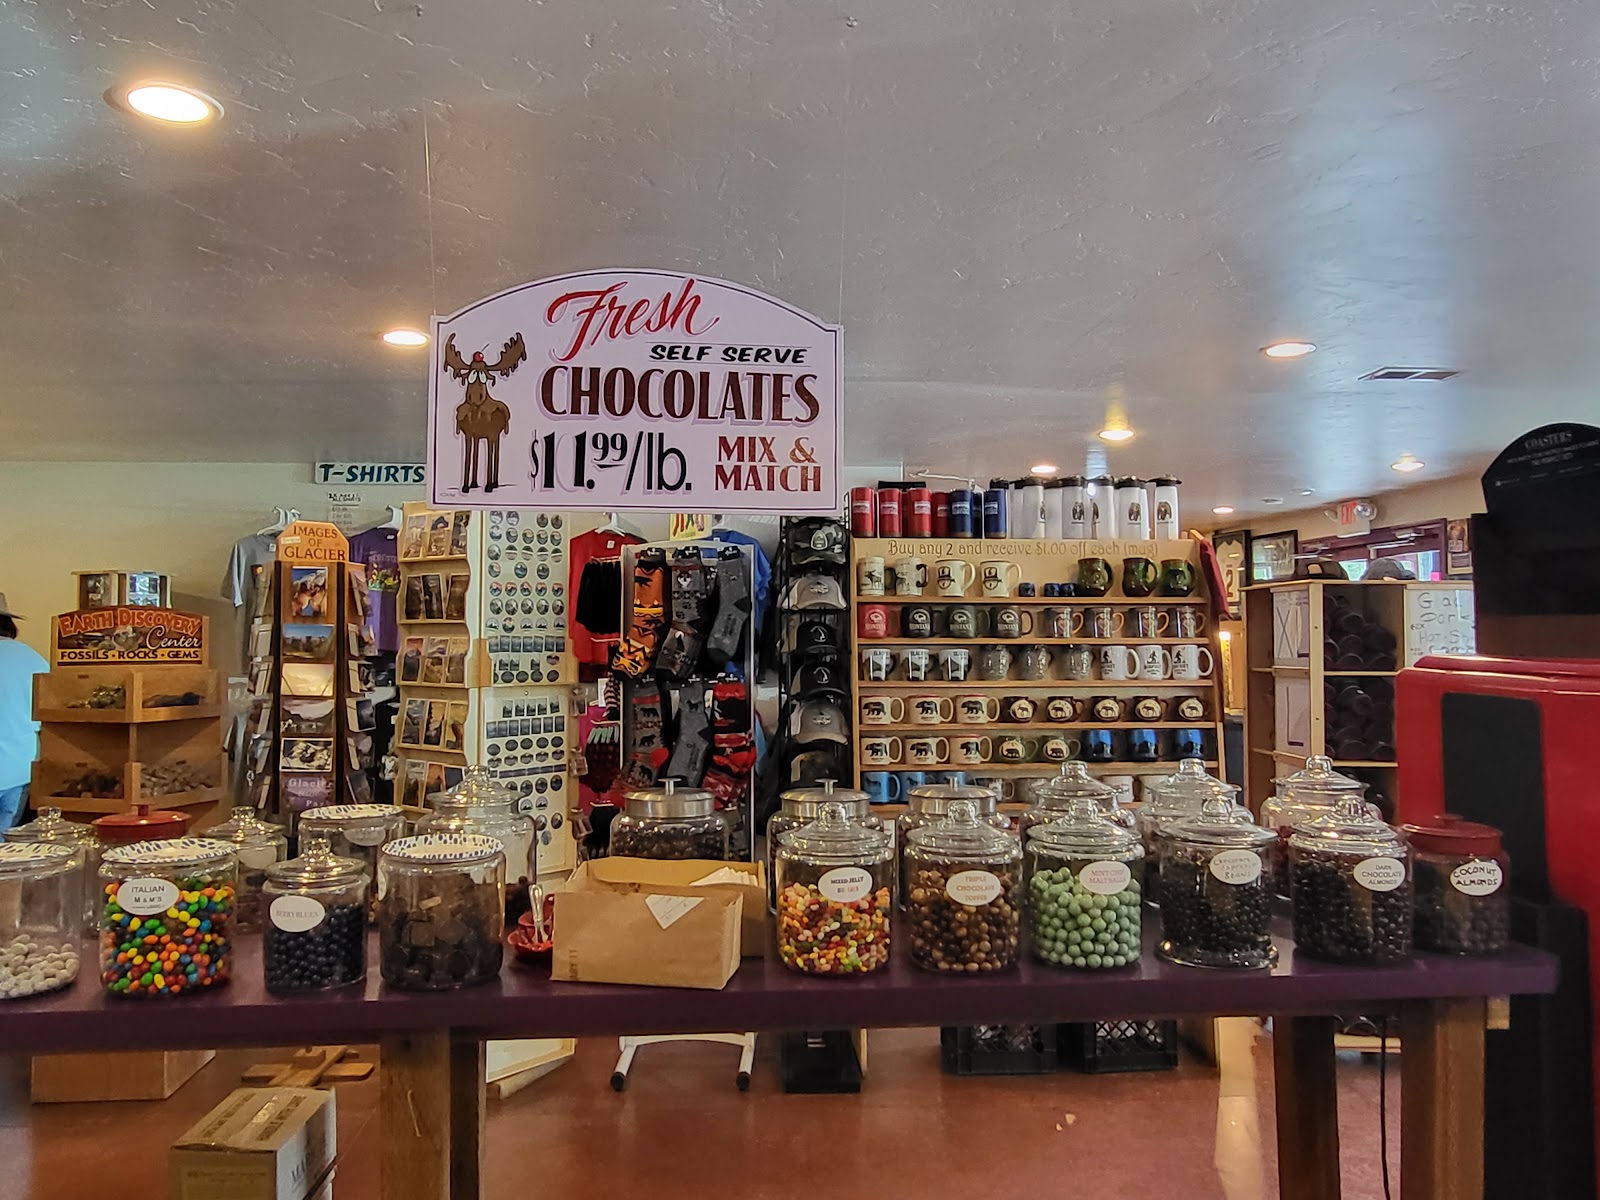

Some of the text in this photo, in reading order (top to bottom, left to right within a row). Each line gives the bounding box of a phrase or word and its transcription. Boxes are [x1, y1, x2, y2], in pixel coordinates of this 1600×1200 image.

[547, 278, 720, 361] Fresh
[649, 345, 808, 364] SELF SERVE
[541, 365, 820, 422] CHOCOLATES
[718, 436, 818, 464] MIX &
[319, 463, 425, 483] T-SHIRTS
[715, 464, 821, 492] MATCH
[293, 525, 338, 539] IMAGES
[308, 538, 323, 547] OF
[888, 540, 914, 558] Buy
[919, 543, 942, 558] any
[946, 543, 953, 556] 2
[959, 542, 982, 555] and
[986, 543, 1031, 556] receive
[1035, 543, 1066, 556] $1.00
[1070, 542, 1087, 558] off
[1091, 543, 1119, 556] each
[284, 546, 346, 561] GLACIER
[58, 607, 202, 637] EARTH DISCOVERY
[146, 625, 202, 650] Center
[60, 649, 199, 660] FOSSILS ROCKS GEMS
[848, 876, 864, 884] JELLY
[1453, 866, 1496, 878] COCONUT
[131, 885, 165, 893] ITALIAN
[1455, 878, 1498, 886] ALMONDS
